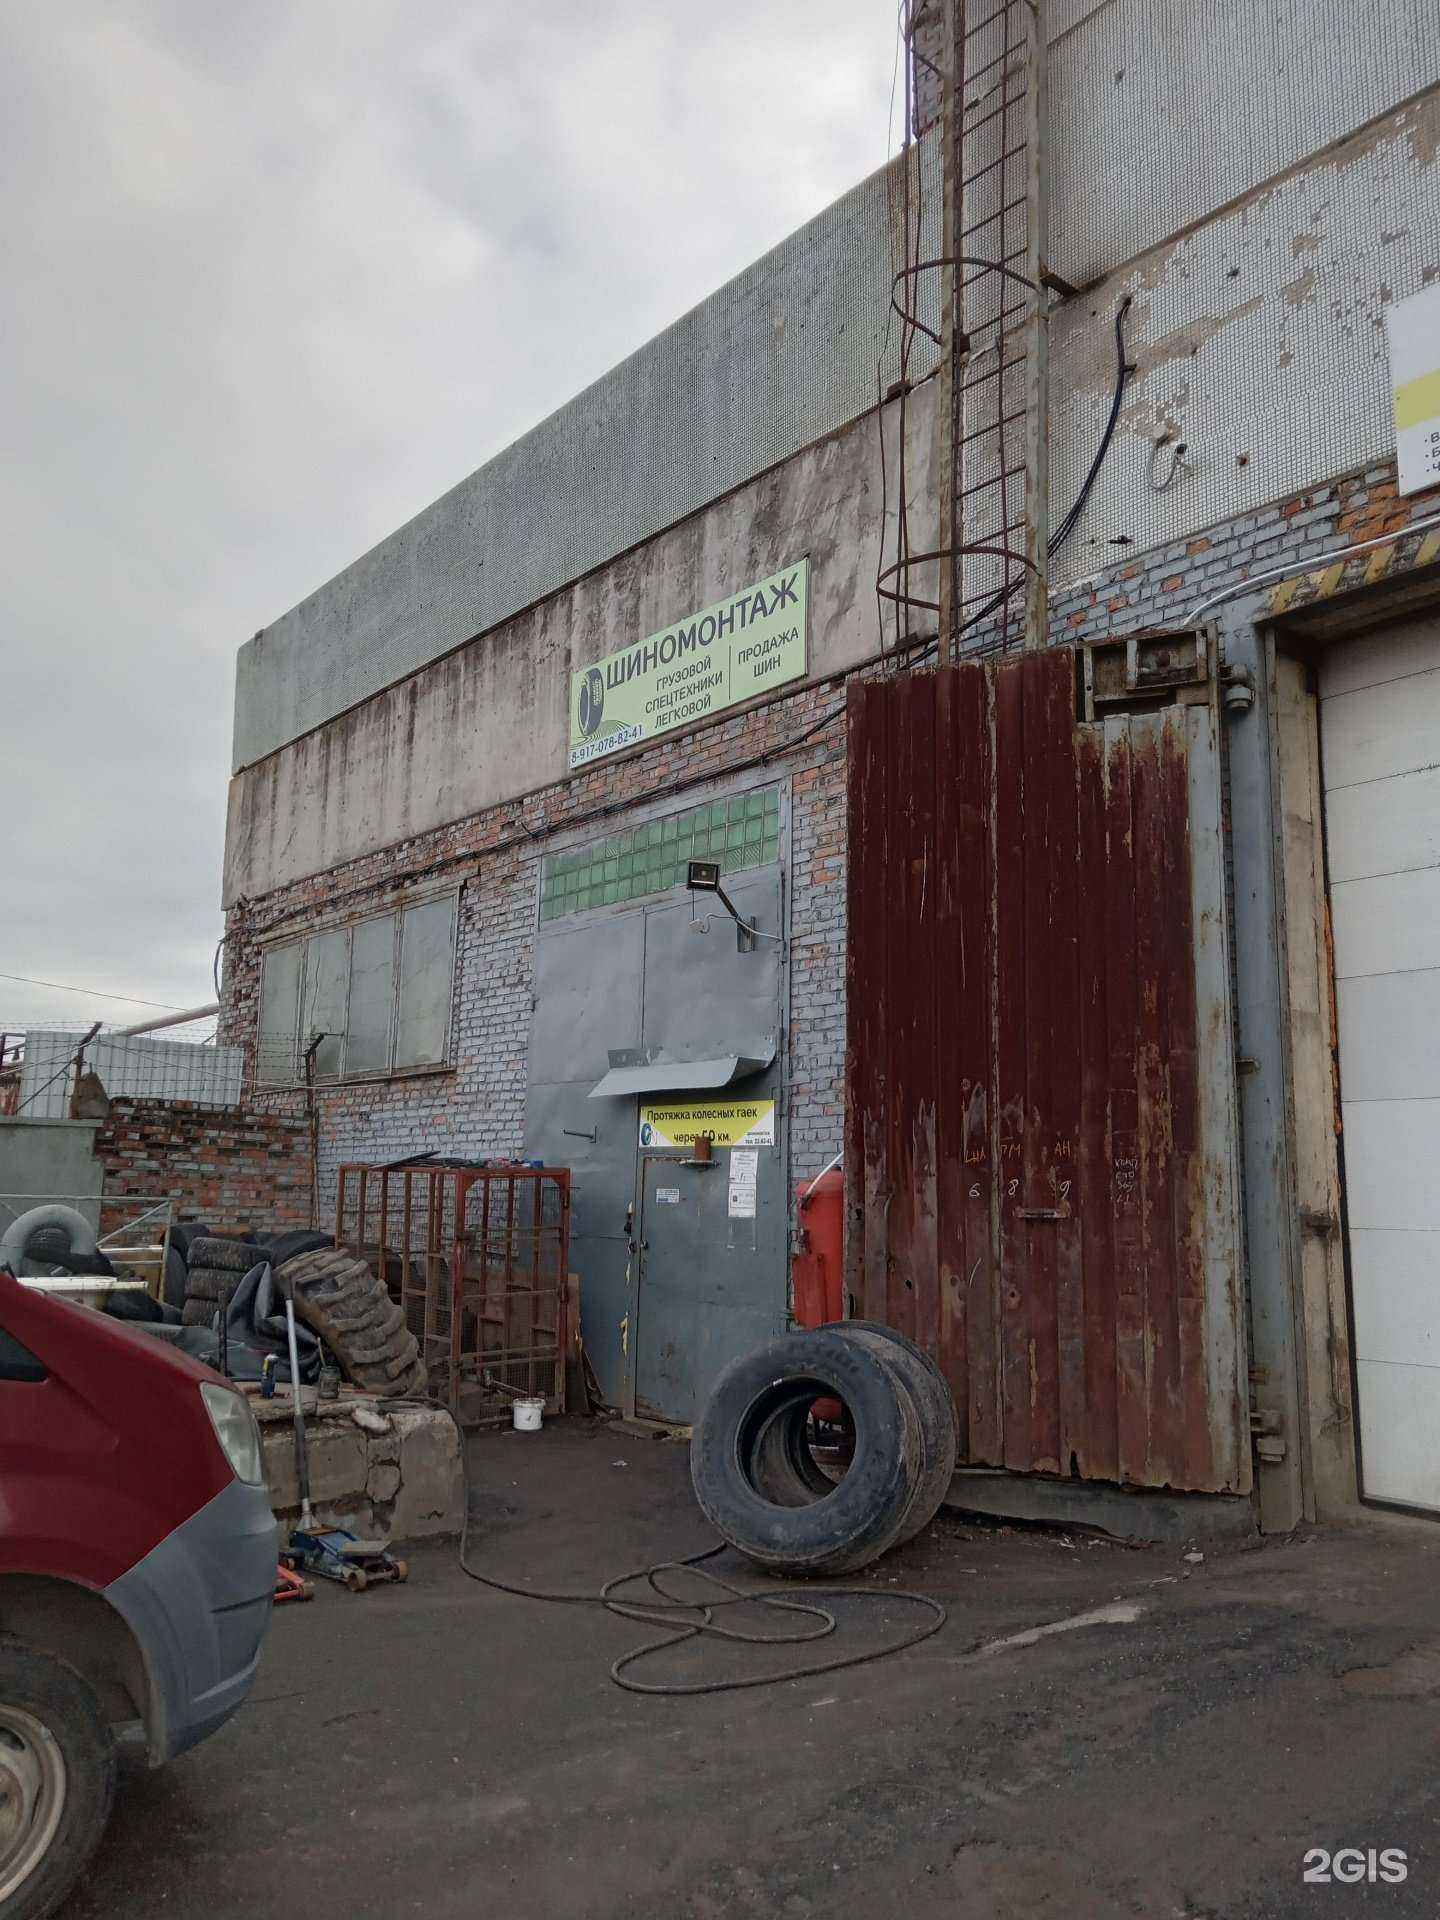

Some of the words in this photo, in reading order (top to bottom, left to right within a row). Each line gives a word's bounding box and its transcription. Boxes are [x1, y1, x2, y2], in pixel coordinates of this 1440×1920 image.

[606, 572, 799, 689] ШИНОМОНТАЖ
[738, 626, 799, 665] ПРОДАЖА
[656, 655, 711, 692] ГРУЗОВОЙ
[753, 654, 781, 678] ШИН
[645, 671, 723, 714] СПЕЦТЕХНИКИ
[654, 694, 711, 729] ЛЕГКОВОЙ
[571, 724, 642, 764] 8-917-078-82-41
[647, 1110, 691, 1124] Протяжка
[692, 1108, 734, 1120] колесных
[736, 1106, 757, 1118] гаек
